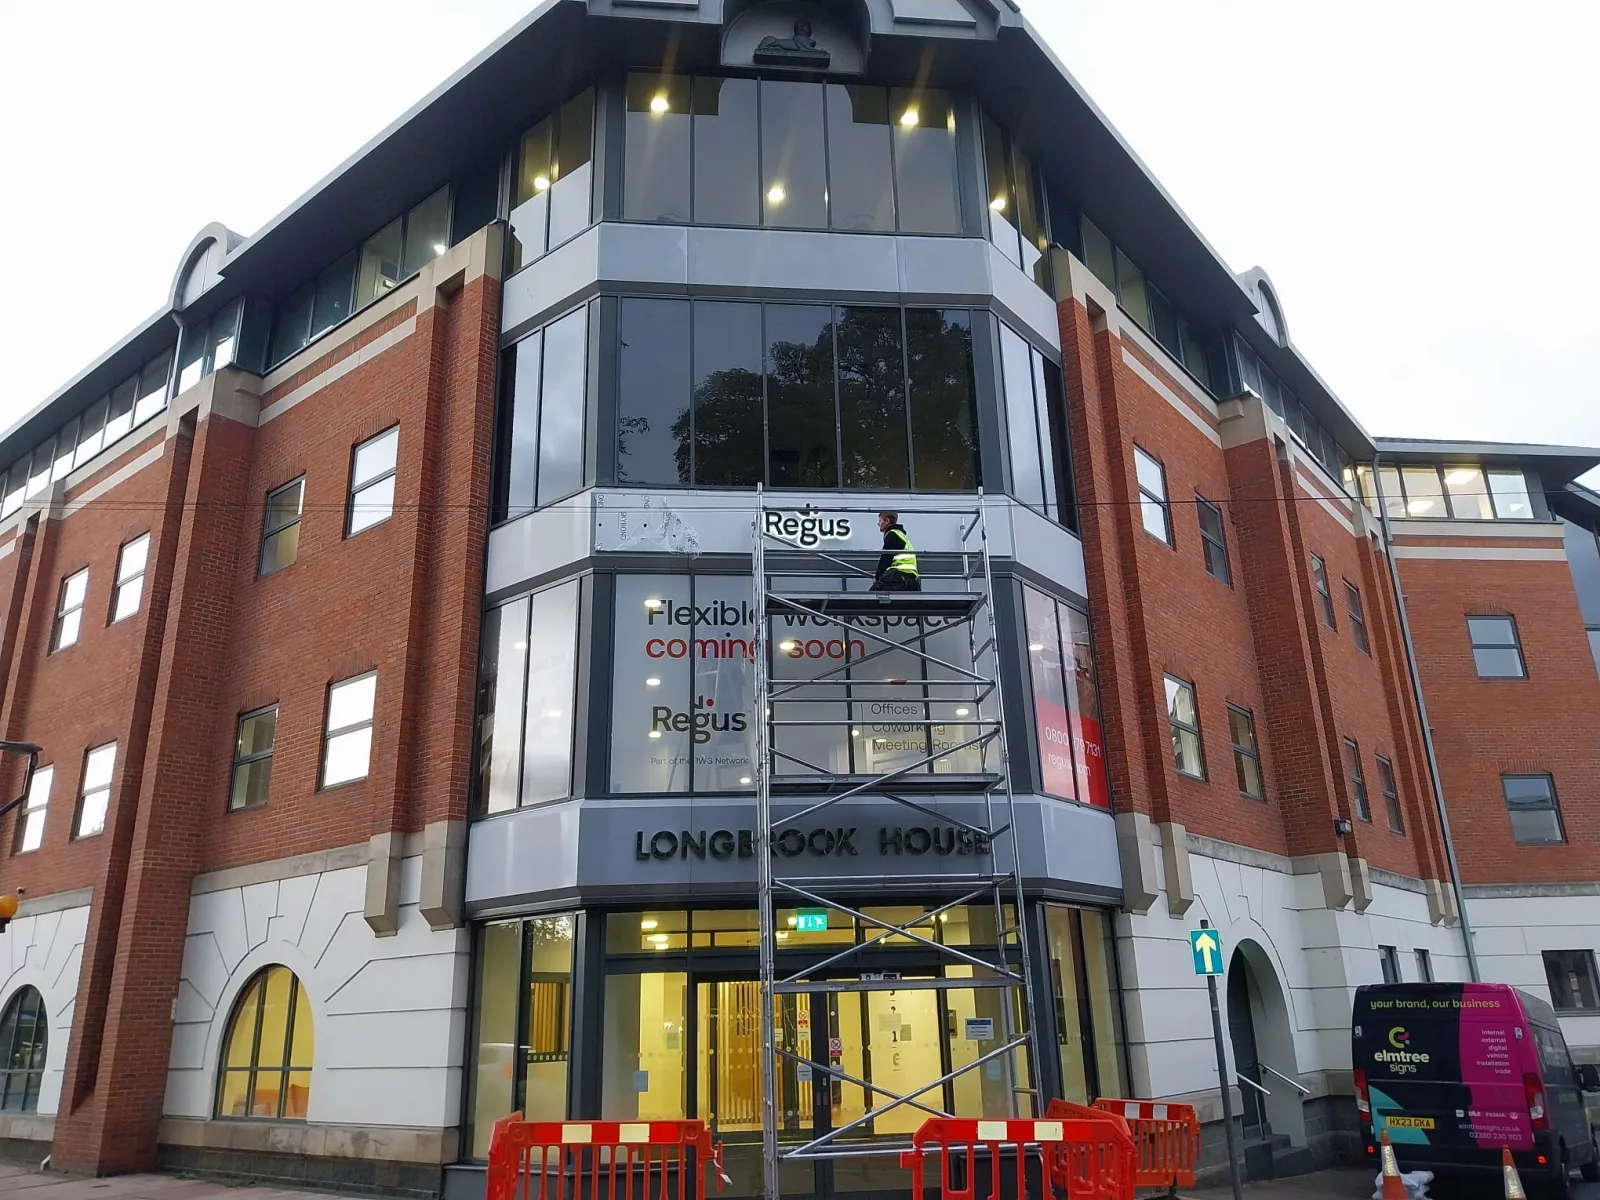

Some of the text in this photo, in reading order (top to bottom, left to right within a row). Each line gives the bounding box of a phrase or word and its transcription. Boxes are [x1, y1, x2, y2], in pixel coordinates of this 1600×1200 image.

[765, 507, 851, 546] Regus
[787, 639, 866, 660] soon
[870, 703, 918, 715] Offices
[652, 705, 748, 744] Regus
[871, 723, 946, 736] Coworkg
[872, 738, 928, 754] Meeting
[1045, 726, 1069, 747] 0800
[1085, 740, 1101, 758] 7131
[650, 757, 749, 765] Part of the IWG Network
[1048, 752, 1092, 777] regusom
[879, 826, 991, 856] HOUSE
[1370, 999, 1501, 1010] your brand, our business
[1374, 1049, 1430, 1063] elmtree
[1389, 1061, 1417, 1075] signs
[1389, 1117, 1431, 1128] HX23 GKA
